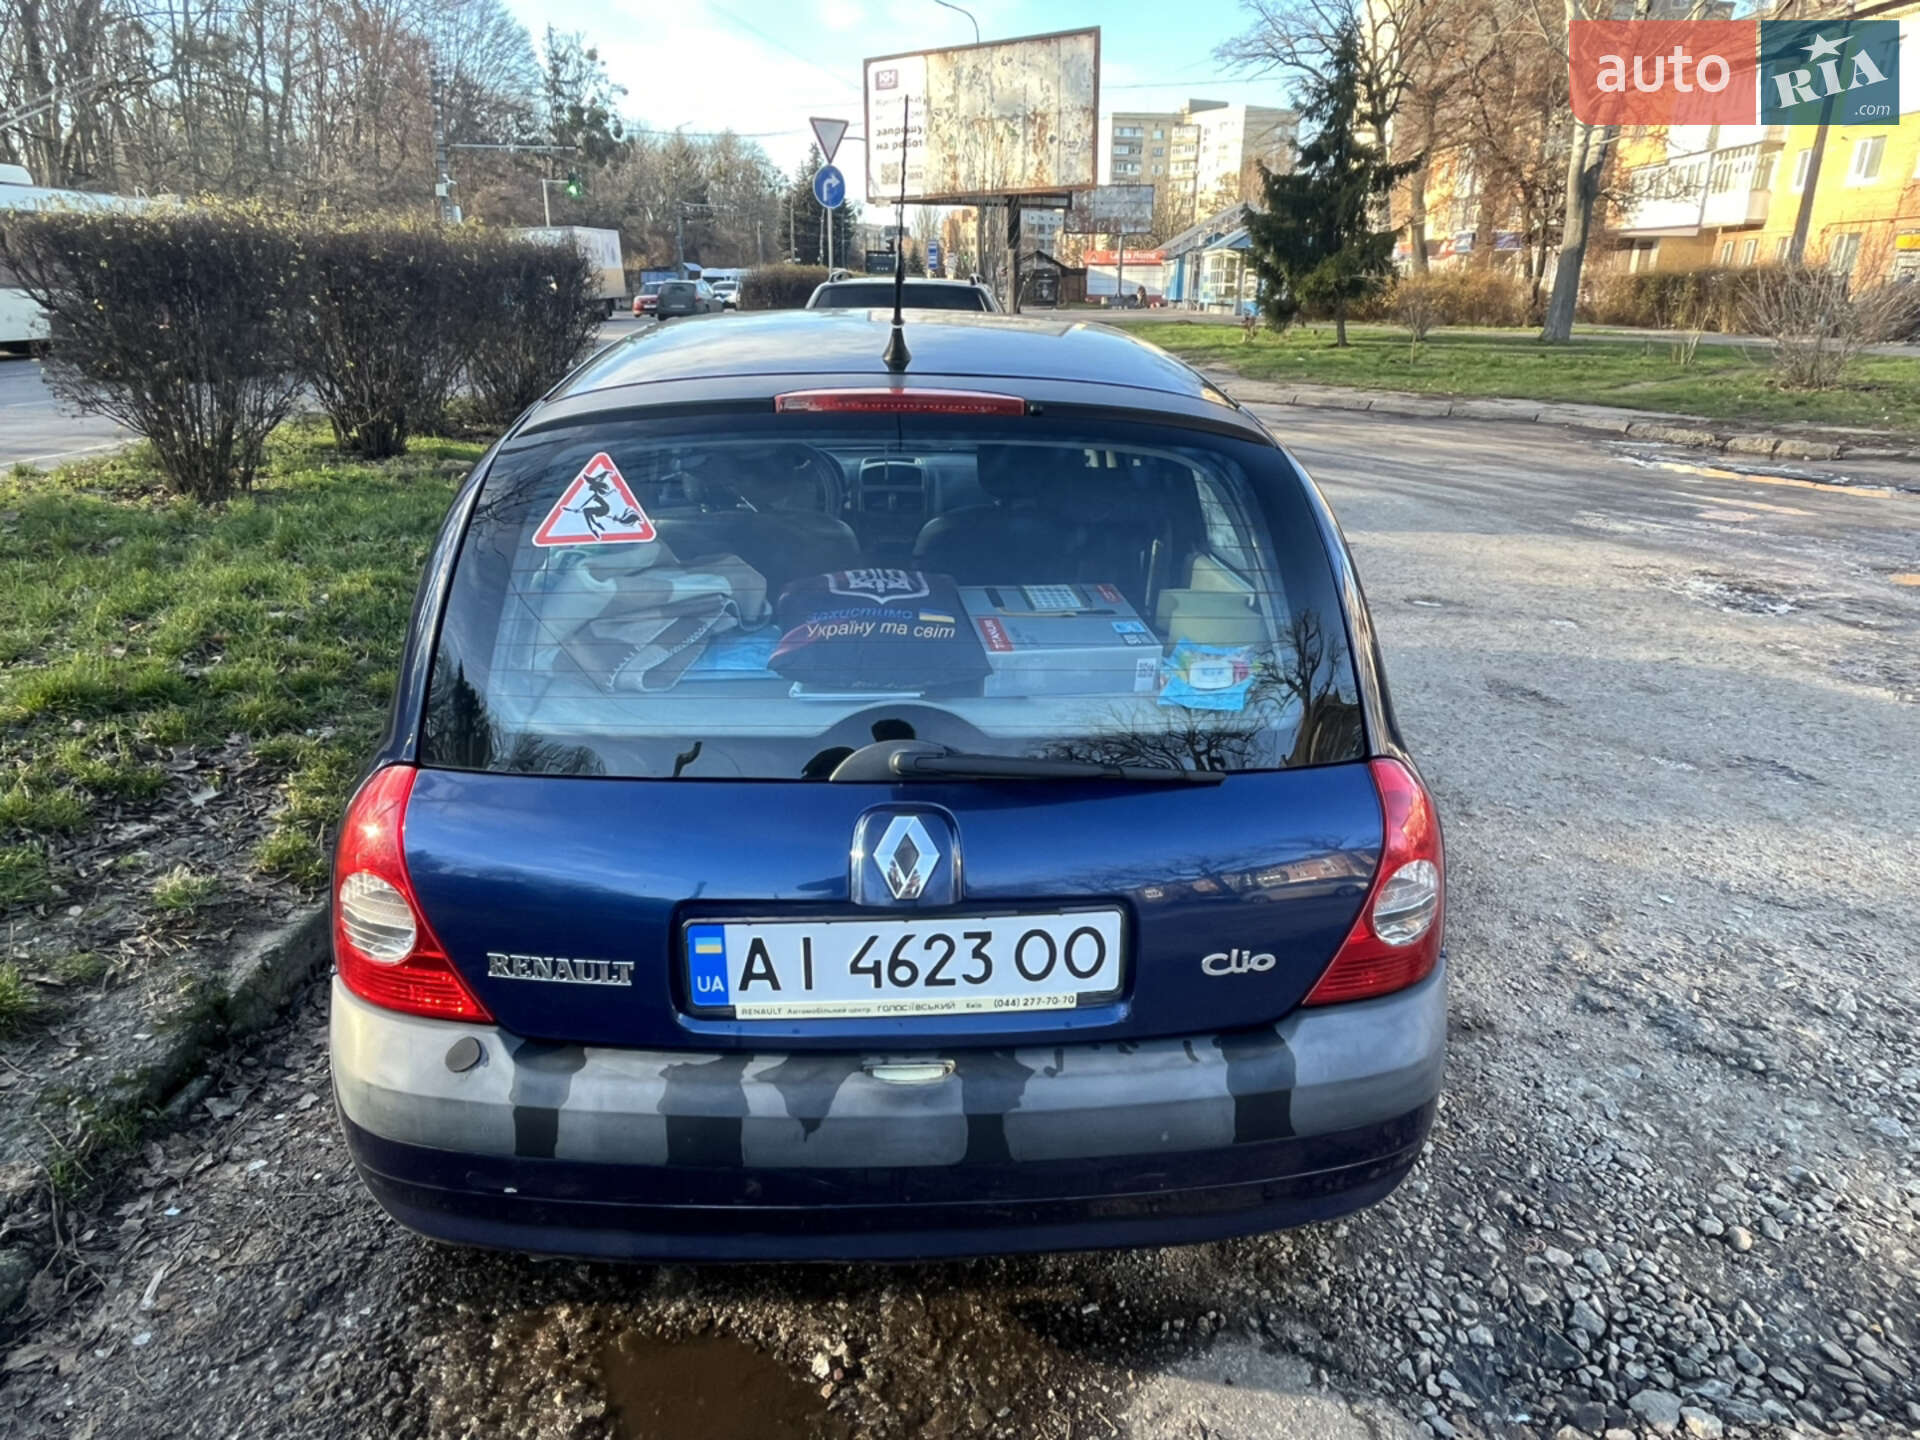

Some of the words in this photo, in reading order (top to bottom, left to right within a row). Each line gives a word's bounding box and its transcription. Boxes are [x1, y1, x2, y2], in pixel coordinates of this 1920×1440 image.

[876, 142, 889, 150] на
[807, 620, 876, 639] Україну
[880, 622, 908, 635] та
[913, 625, 955, 639] світ
[487, 952, 634, 986] RENAULT
[738, 937, 813, 991] AI
[849, 931, 993, 989] 4623
[1201, 948, 1277, 976] Clio
[697, 975, 725, 992] UA
[741, 1007, 783, 1015] RENAULT
[993, 997, 1021, 1008] (044)
[1023, 995, 1075, 1006] 277-70-70
